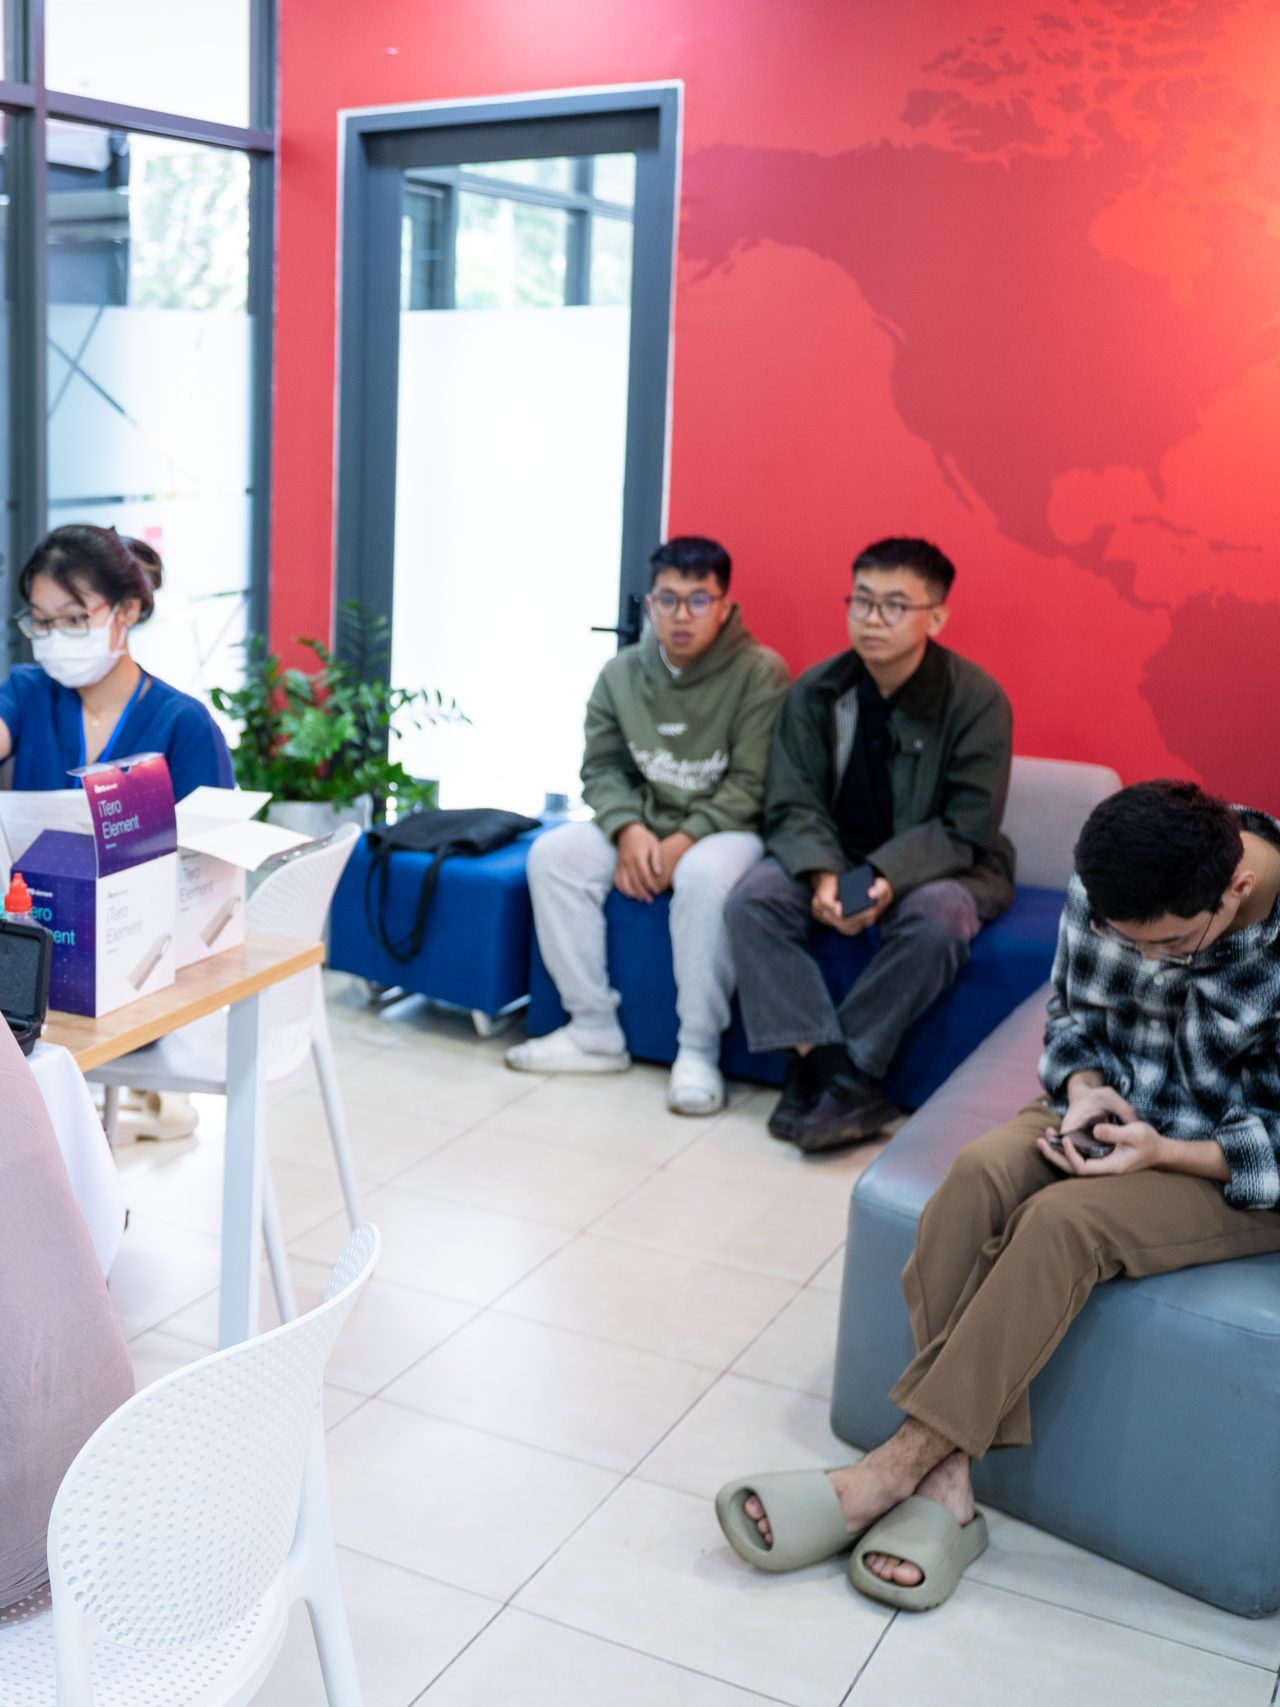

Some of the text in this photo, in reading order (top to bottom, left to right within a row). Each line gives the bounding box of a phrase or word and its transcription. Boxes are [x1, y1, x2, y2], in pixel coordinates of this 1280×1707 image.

[97, 799, 122, 818] iTero
[101, 814, 140, 840] Element
[179, 880, 213, 902] Element
[29, 906, 53, 921] ero
[106, 905, 129, 924] iTero
[106, 919, 142, 945] Element
